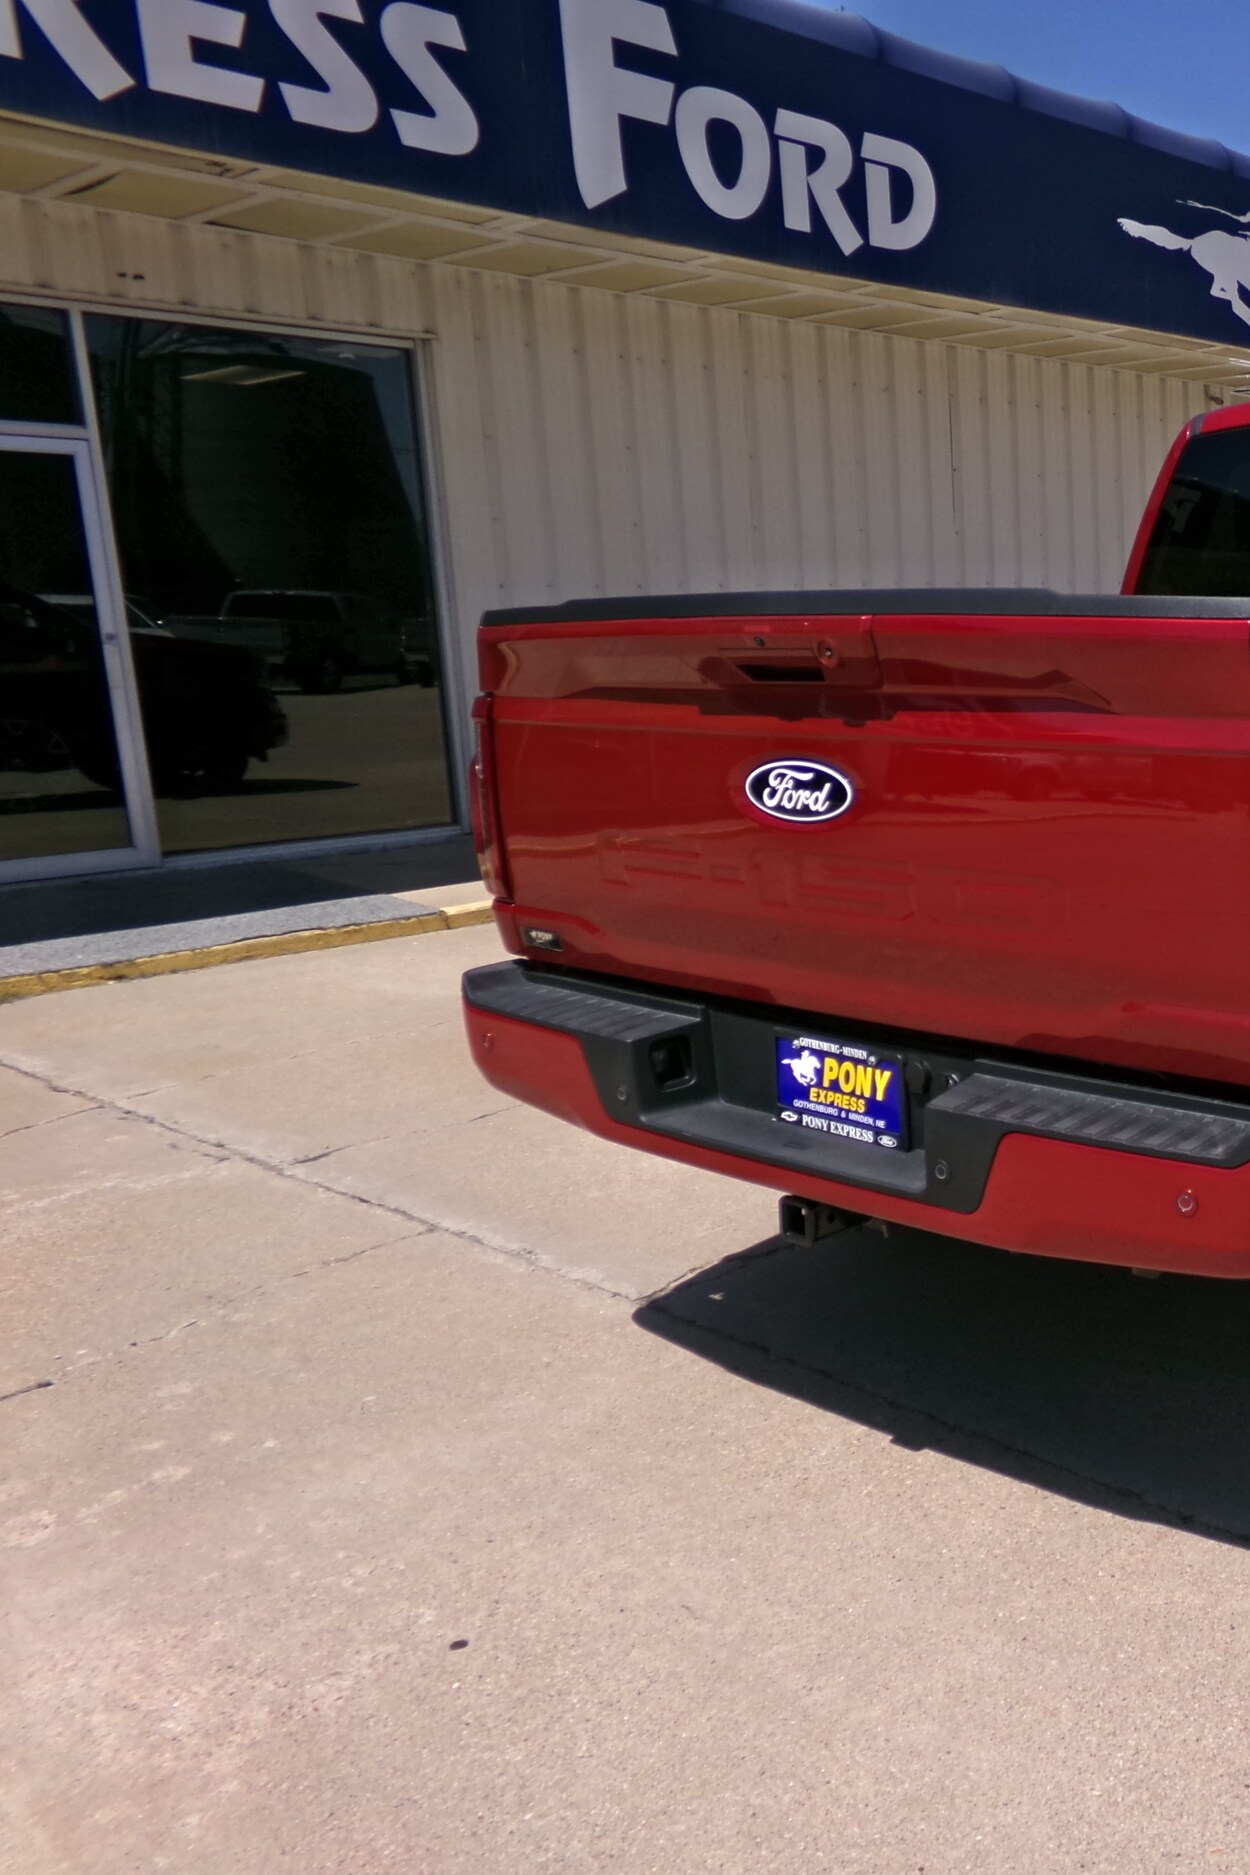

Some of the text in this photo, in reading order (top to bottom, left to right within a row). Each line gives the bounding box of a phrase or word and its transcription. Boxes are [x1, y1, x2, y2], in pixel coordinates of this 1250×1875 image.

[762, 768, 831, 812] Ford
[822, 1057, 892, 1101] PONY
[792, 1099, 839, 1117] GOTHENBURG
[875, 1119, 886, 1128] NE
[809, 1087, 866, 1113] EXPRESS
[801, 1114, 829, 1132] PONY
[830, 1121, 874, 1143] EXPRESS
